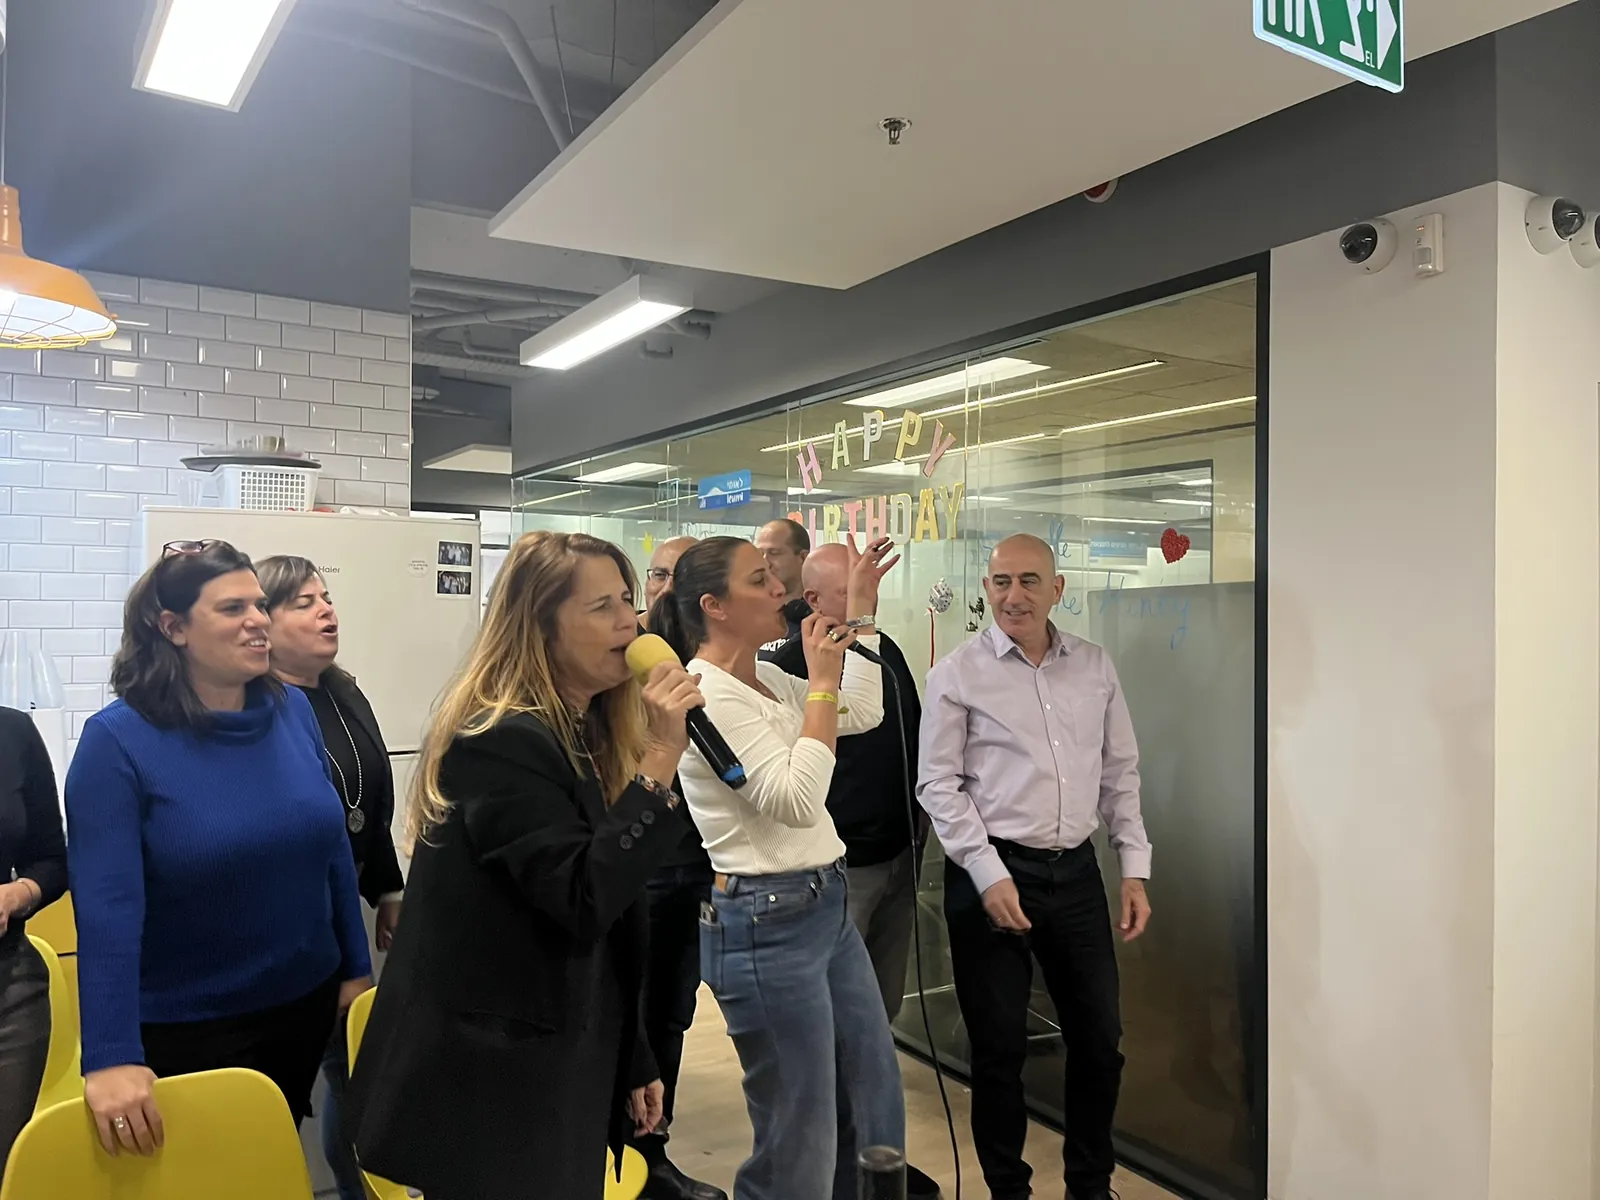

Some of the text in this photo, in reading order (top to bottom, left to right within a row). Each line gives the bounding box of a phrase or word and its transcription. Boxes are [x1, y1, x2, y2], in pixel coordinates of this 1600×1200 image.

[1365, 50, 1375, 68] EL
[796, 409, 957, 494] HAPPY
[318, 565, 341, 573] Haier
